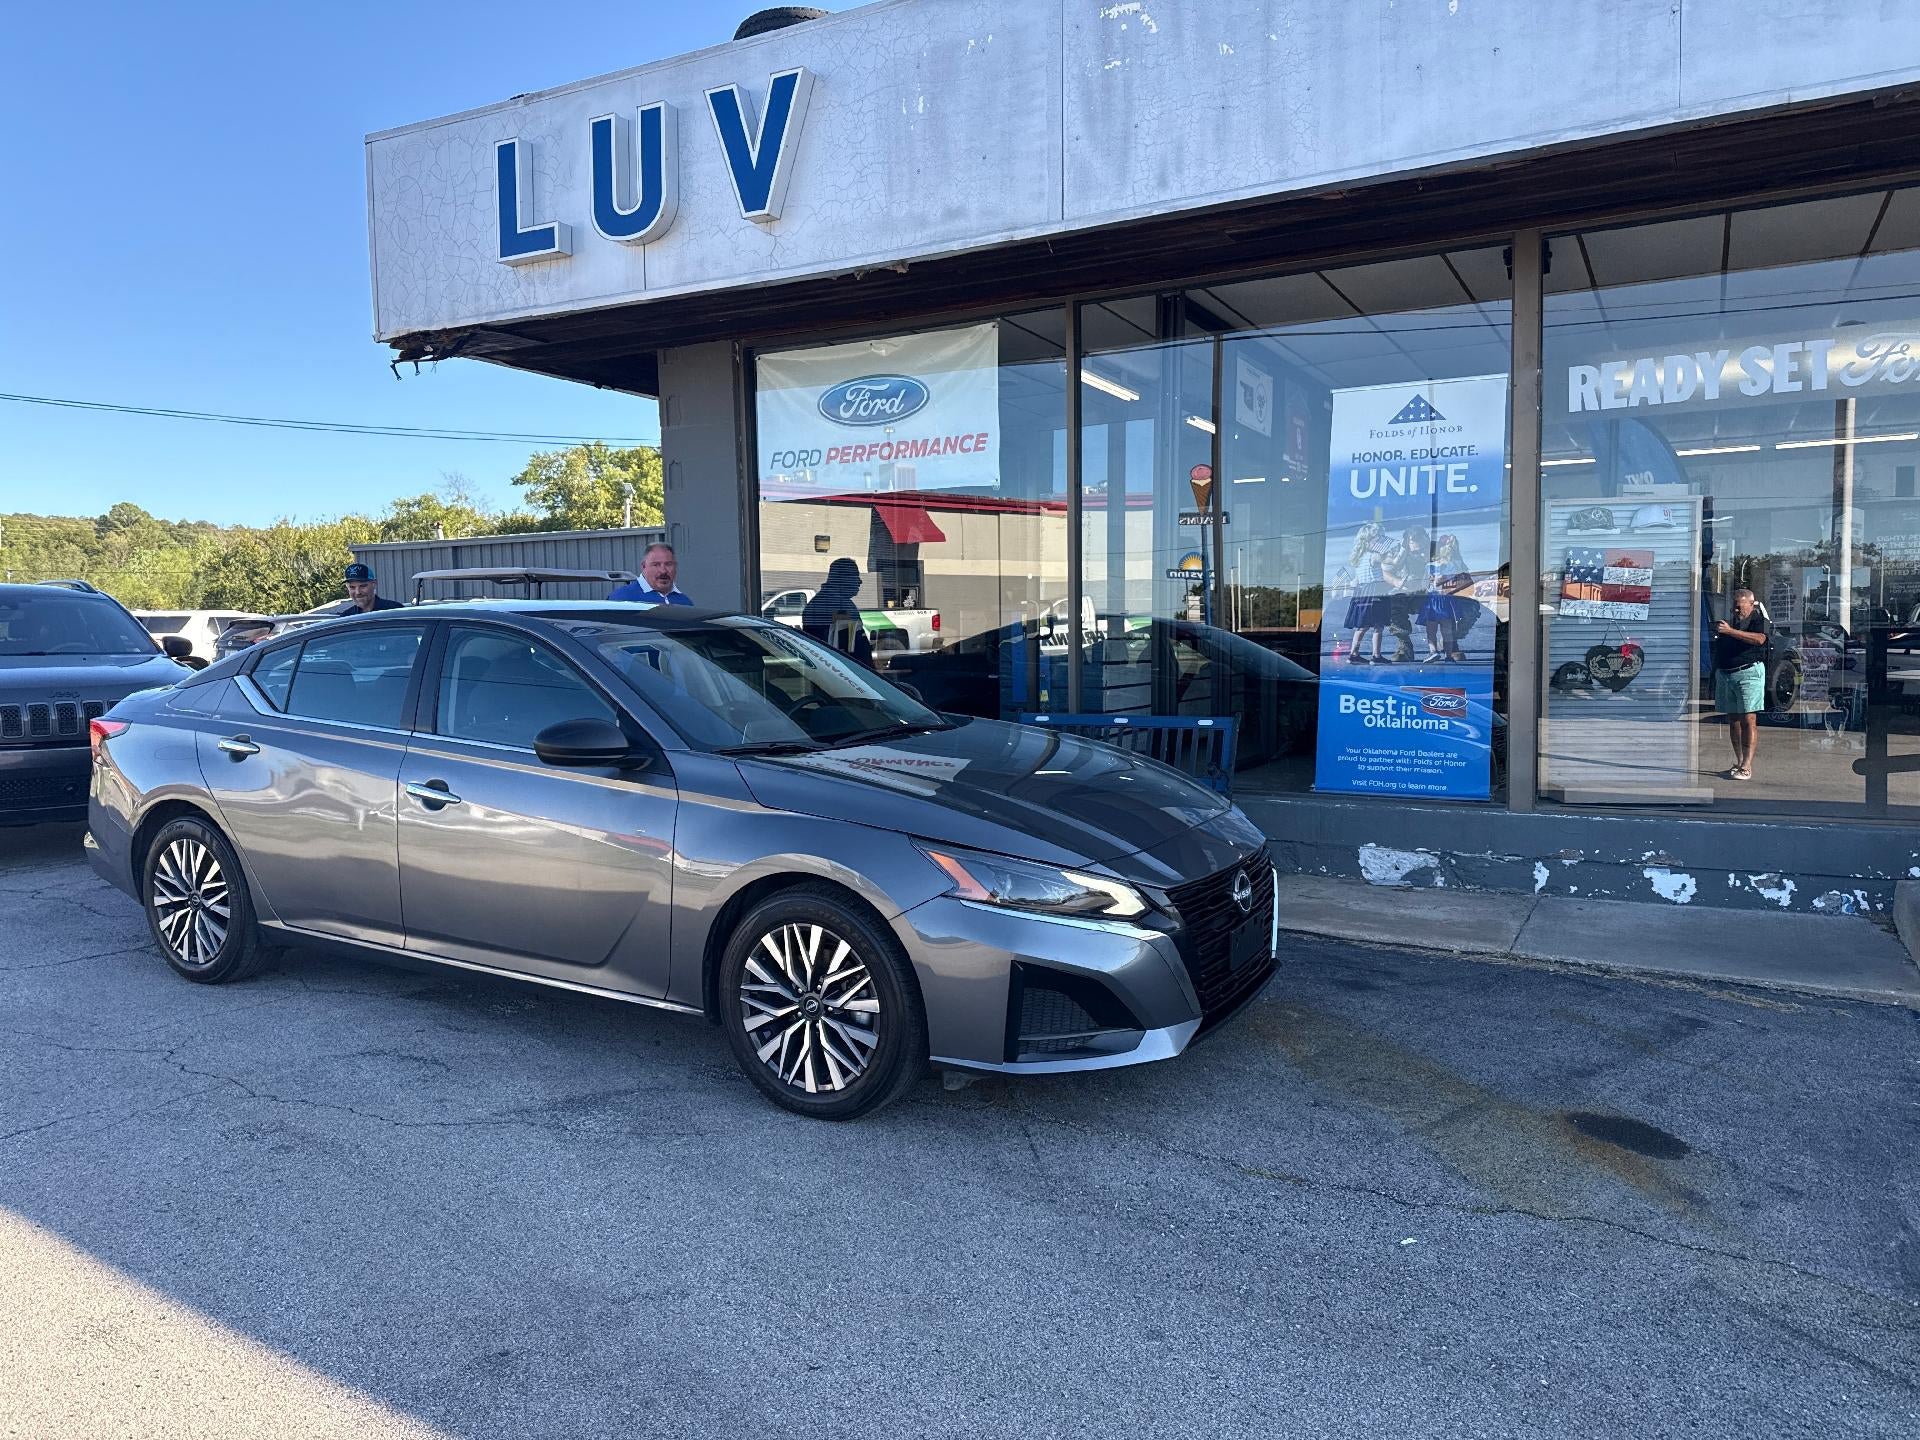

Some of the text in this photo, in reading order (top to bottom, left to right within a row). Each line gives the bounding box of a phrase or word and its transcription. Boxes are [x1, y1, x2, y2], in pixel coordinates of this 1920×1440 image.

[494, 66, 815, 266] LUV
[1568, 332, 1920, 413] READY SET Fo
[839, 383, 906, 419] Ford
[1369, 425, 1463, 439] FOLDS of HONOR
[770, 432, 989, 470] FORD PERFORMANCE
[1351, 444, 1479, 464] HONOR. EDUCATE.
[1350, 462, 1478, 499] UNITE.
[48, 688, 80, 699] Jeep
[1339, 694, 1397, 715] Best
[1401, 701, 1417, 716] in
[1363, 714, 1449, 730] Oklahoma
[1362, 748, 1398, 756] Oklahoma
[1399, 749, 1416, 757] Ford
[1368, 756, 1394, 764] partner
[1366, 764, 1394, 773] support
[1395, 765, 1412, 773] their
[1407, 781, 1426, 790] learn
